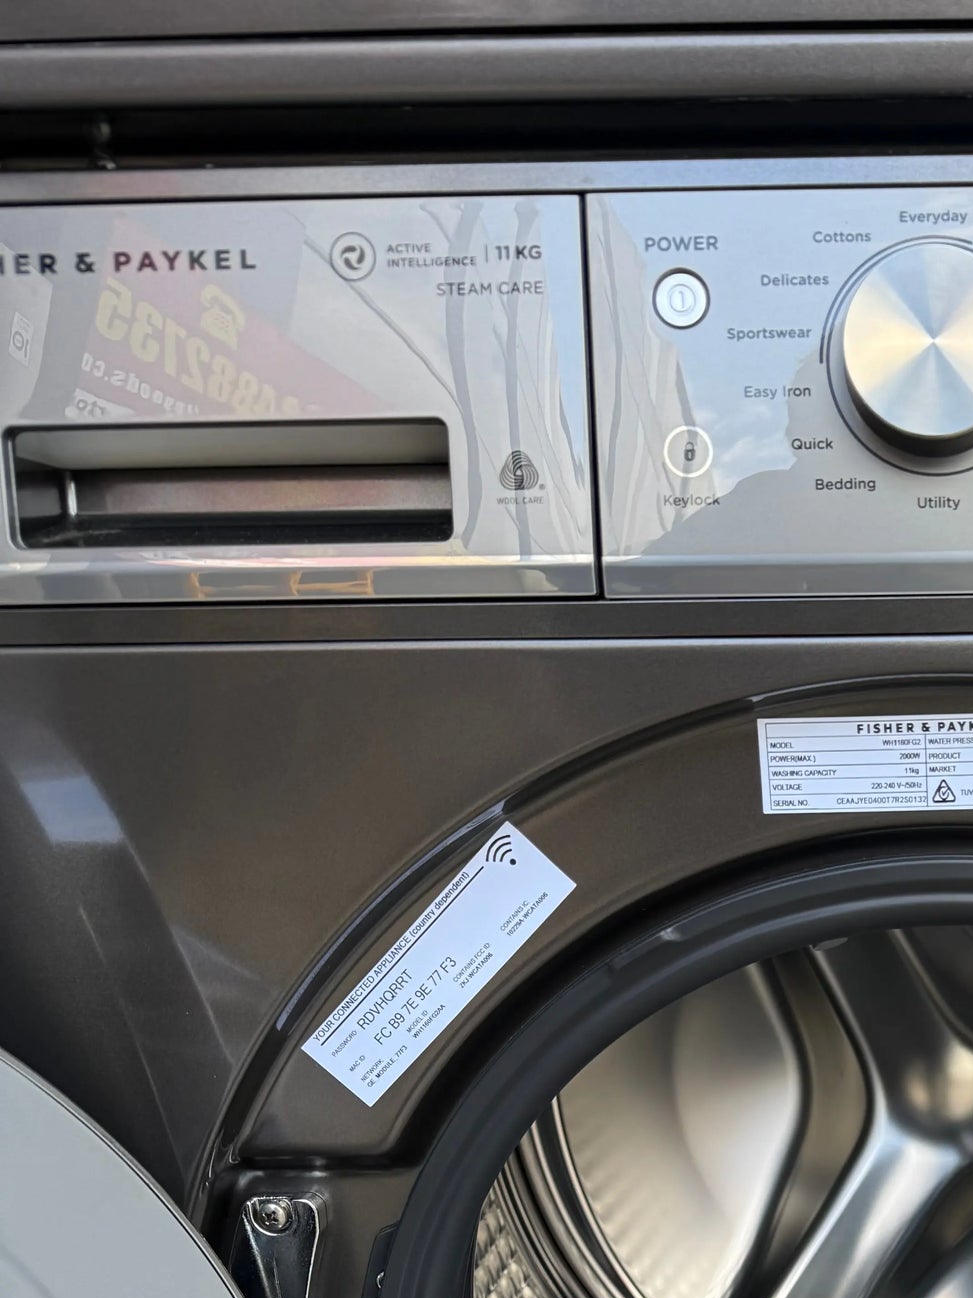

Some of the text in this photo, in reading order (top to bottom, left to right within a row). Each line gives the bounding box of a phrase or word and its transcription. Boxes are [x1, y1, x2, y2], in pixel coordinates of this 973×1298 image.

[900, 210, 967, 225] Everyday
[644, 236, 718, 252] POWER
[813, 231, 871, 244] Cottons
[387, 243, 431, 253] ACTIVE
[75, 252, 95, 273] &
[113, 250, 256, 272] PAYKEL
[387, 256, 477, 267] INTELLIGENCE
[761, 274, 829, 286] Delicates
[437, 281, 543, 296] STEAM CARE
[727, 326, 812, 341] Sportswear
[744, 385, 811, 400] Easy Iron
[791, 437, 834, 450] Quick
[815, 477, 876, 492] Bedding
[496, 495, 544, 505] WOOL CARE
[663, 493, 720, 507] Keylock
[917, 496, 960, 511] Utility
[857, 723, 914, 734] FISHER
[922, 722, 931, 732] &
[770, 741, 794, 749] MODEL
[928, 737, 951, 745] WATER
[900, 752, 920, 760] 2000W
[928, 752, 961, 760] PRODUCT
[772, 768, 836, 778] WASHING CAPACITY
[929, 765, 956, 774] MARKET
[772, 783, 802, 791] VOLTAGE
[774, 799, 796, 807] SERIAL
[312, 869, 471, 1043] YOUR CONNECTED APPLIANCE (country dependent)
[356, 968, 415, 1030] RDVHQRRT
[374, 955, 458, 1045] FC B9 7E 9E 77 F3
